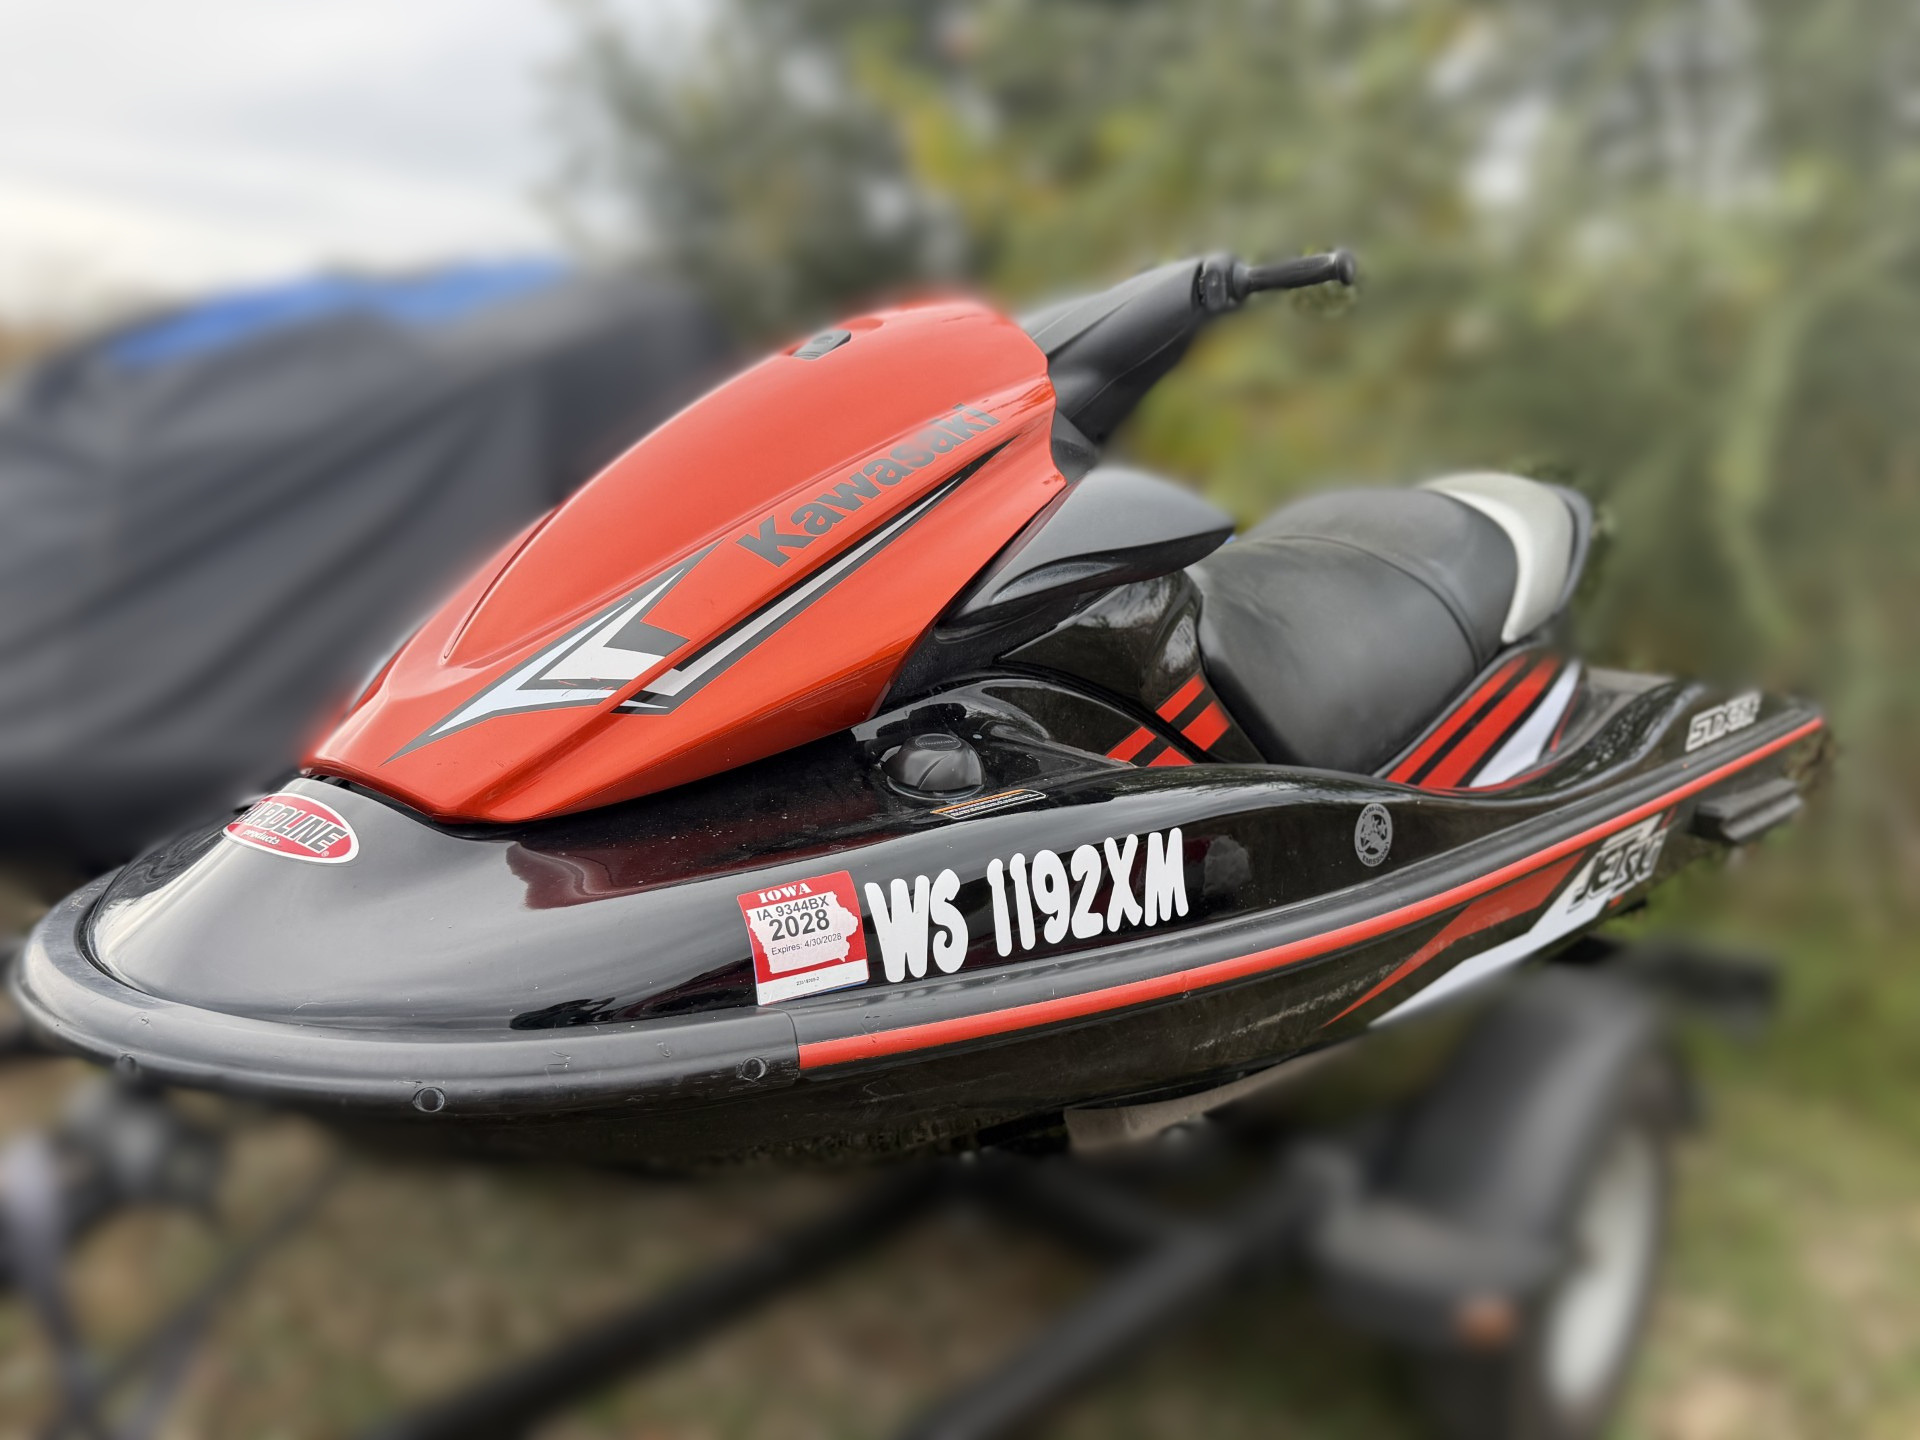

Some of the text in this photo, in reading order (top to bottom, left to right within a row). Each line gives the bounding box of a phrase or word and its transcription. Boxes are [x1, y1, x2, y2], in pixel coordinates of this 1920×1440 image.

[735, 403, 1000, 567] Kawasaki
[756, 895, 830, 921] IA 9344BX
[758, 883, 812, 904] IOWA
[864, 827, 1189, 983] WS 1192XM
[768, 908, 830, 942] 2028
[771, 932, 842, 956] Expires: 4/30/2028
